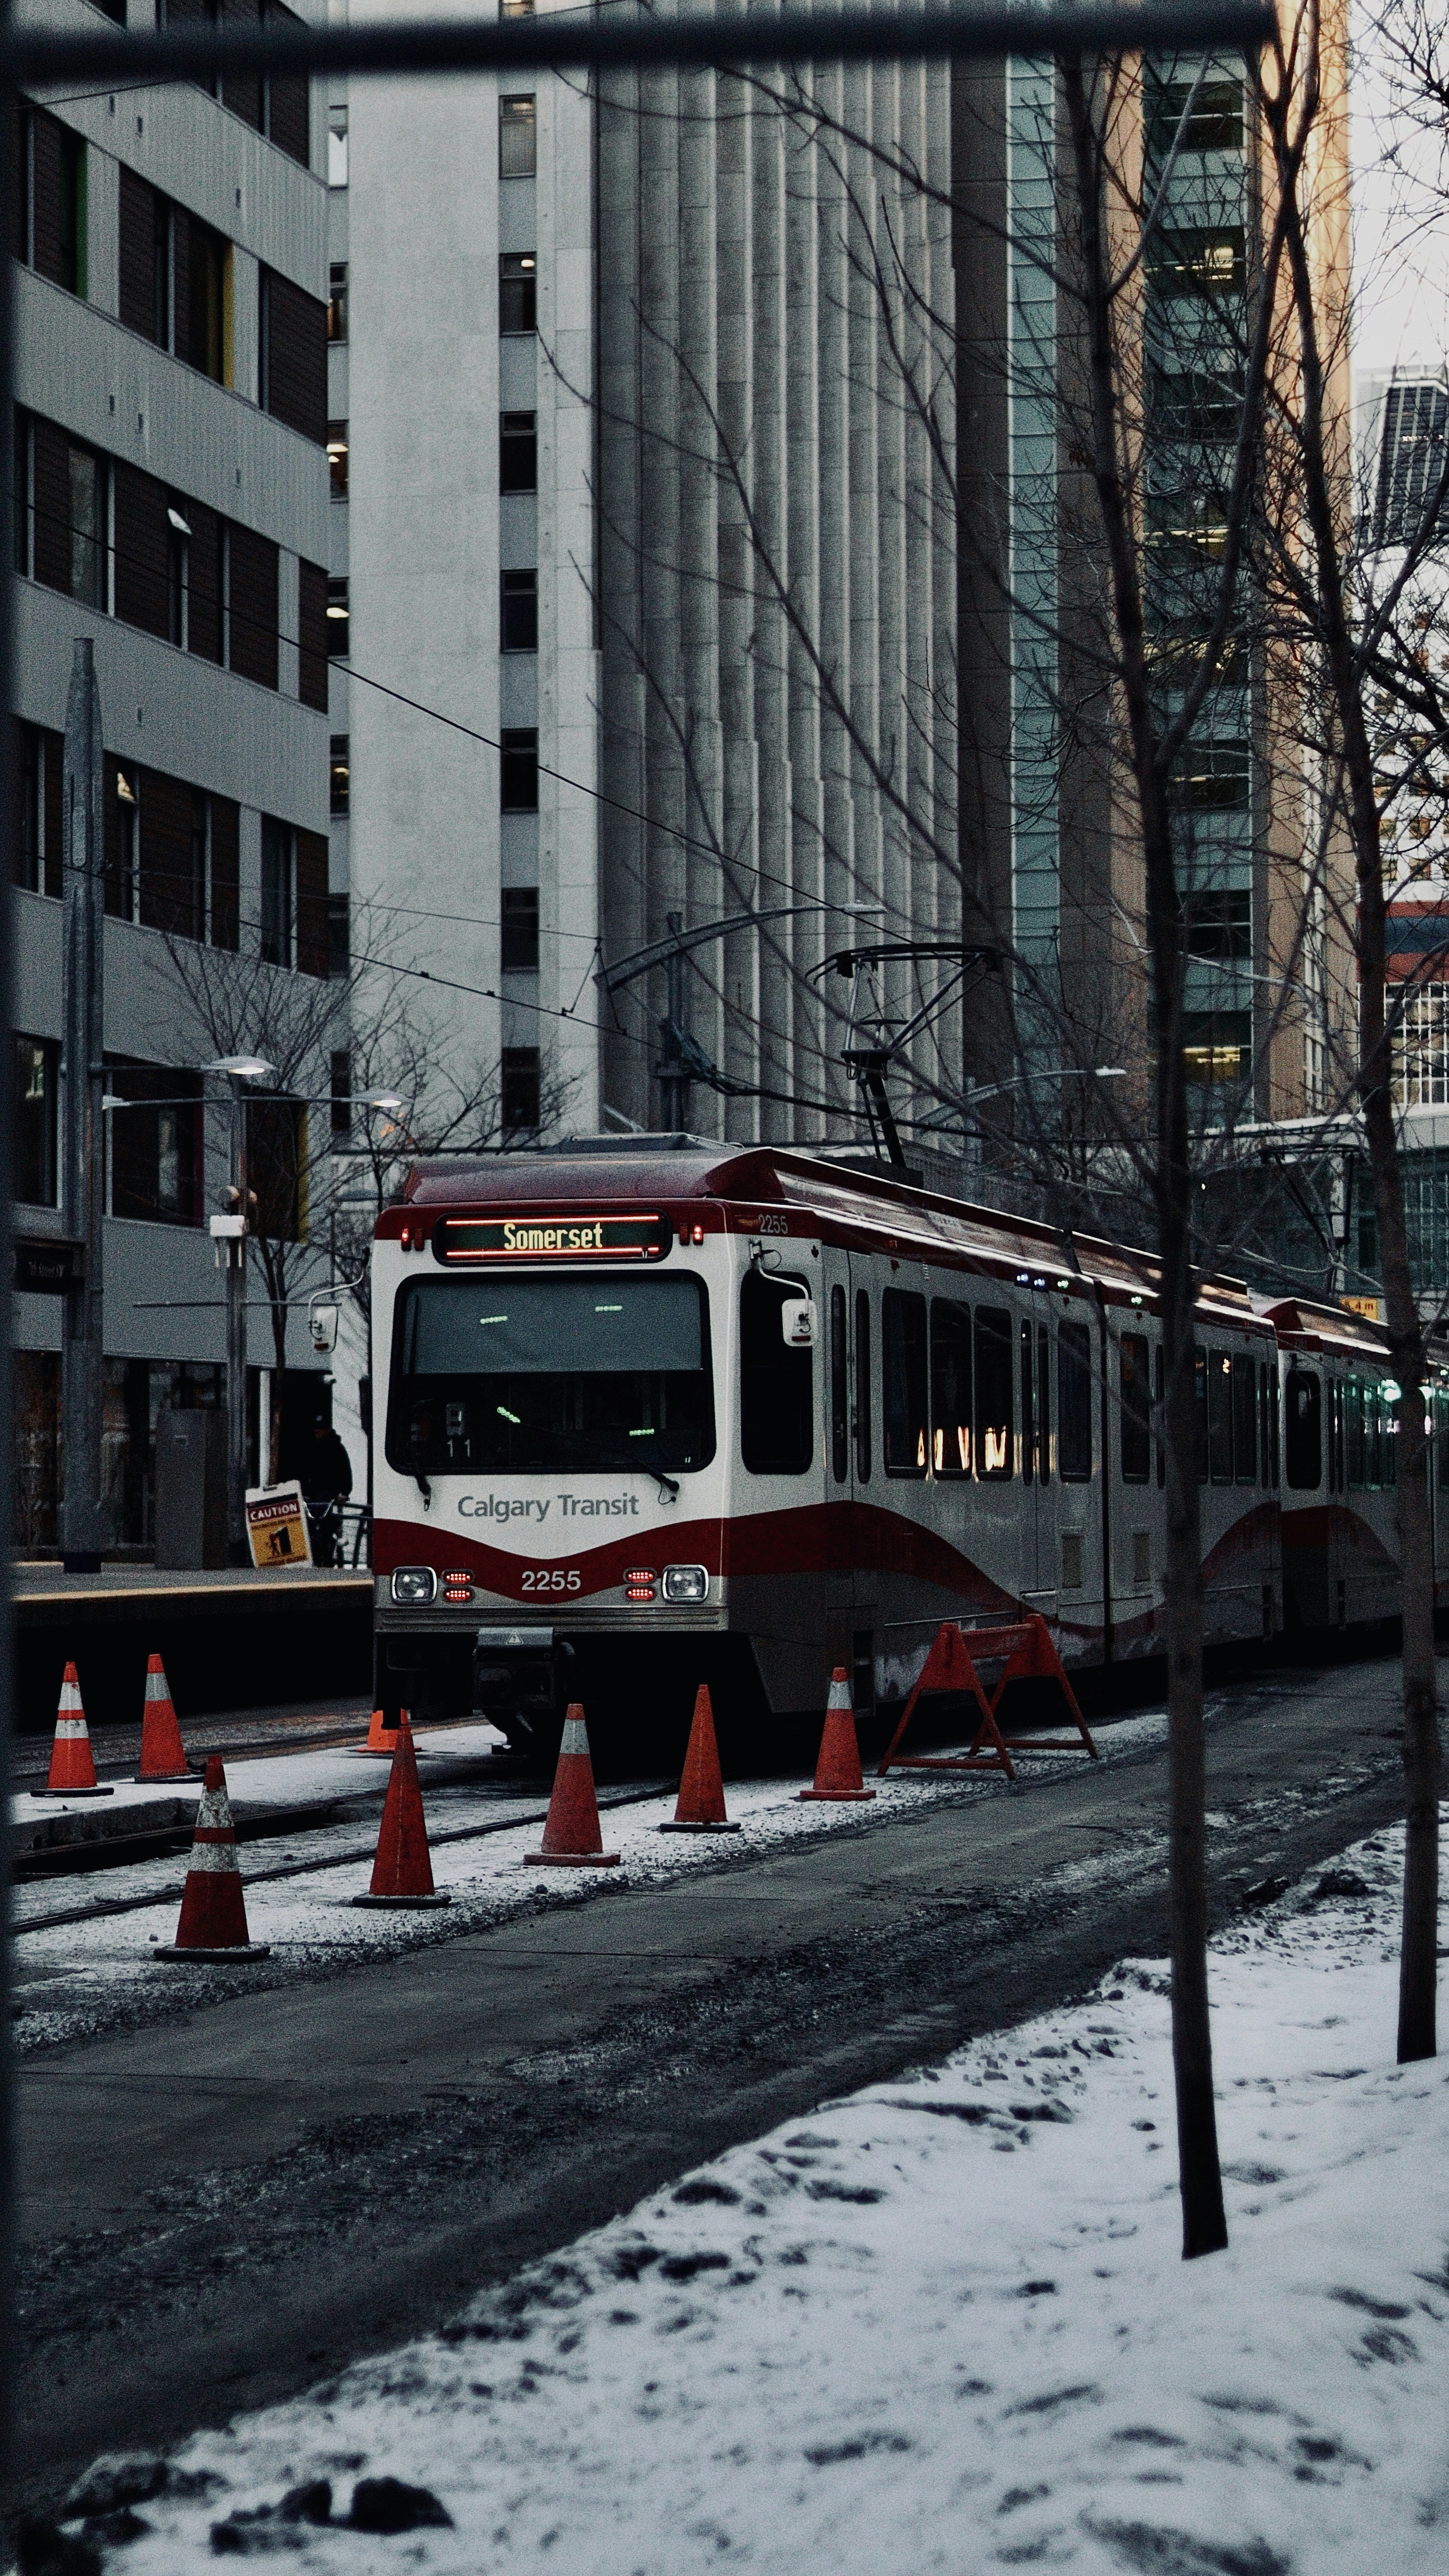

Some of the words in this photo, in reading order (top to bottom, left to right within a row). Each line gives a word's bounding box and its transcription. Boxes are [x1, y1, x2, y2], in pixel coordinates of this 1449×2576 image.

[758, 1214, 788, 1234] 2255
[504, 1222, 603, 1250] Somerset
[250, 1503, 298, 1521] CAUTION
[457, 1494, 551, 1523] Calgary
[557, 1492, 640, 1516] Transit
[521, 1570, 581, 1590] 2255
